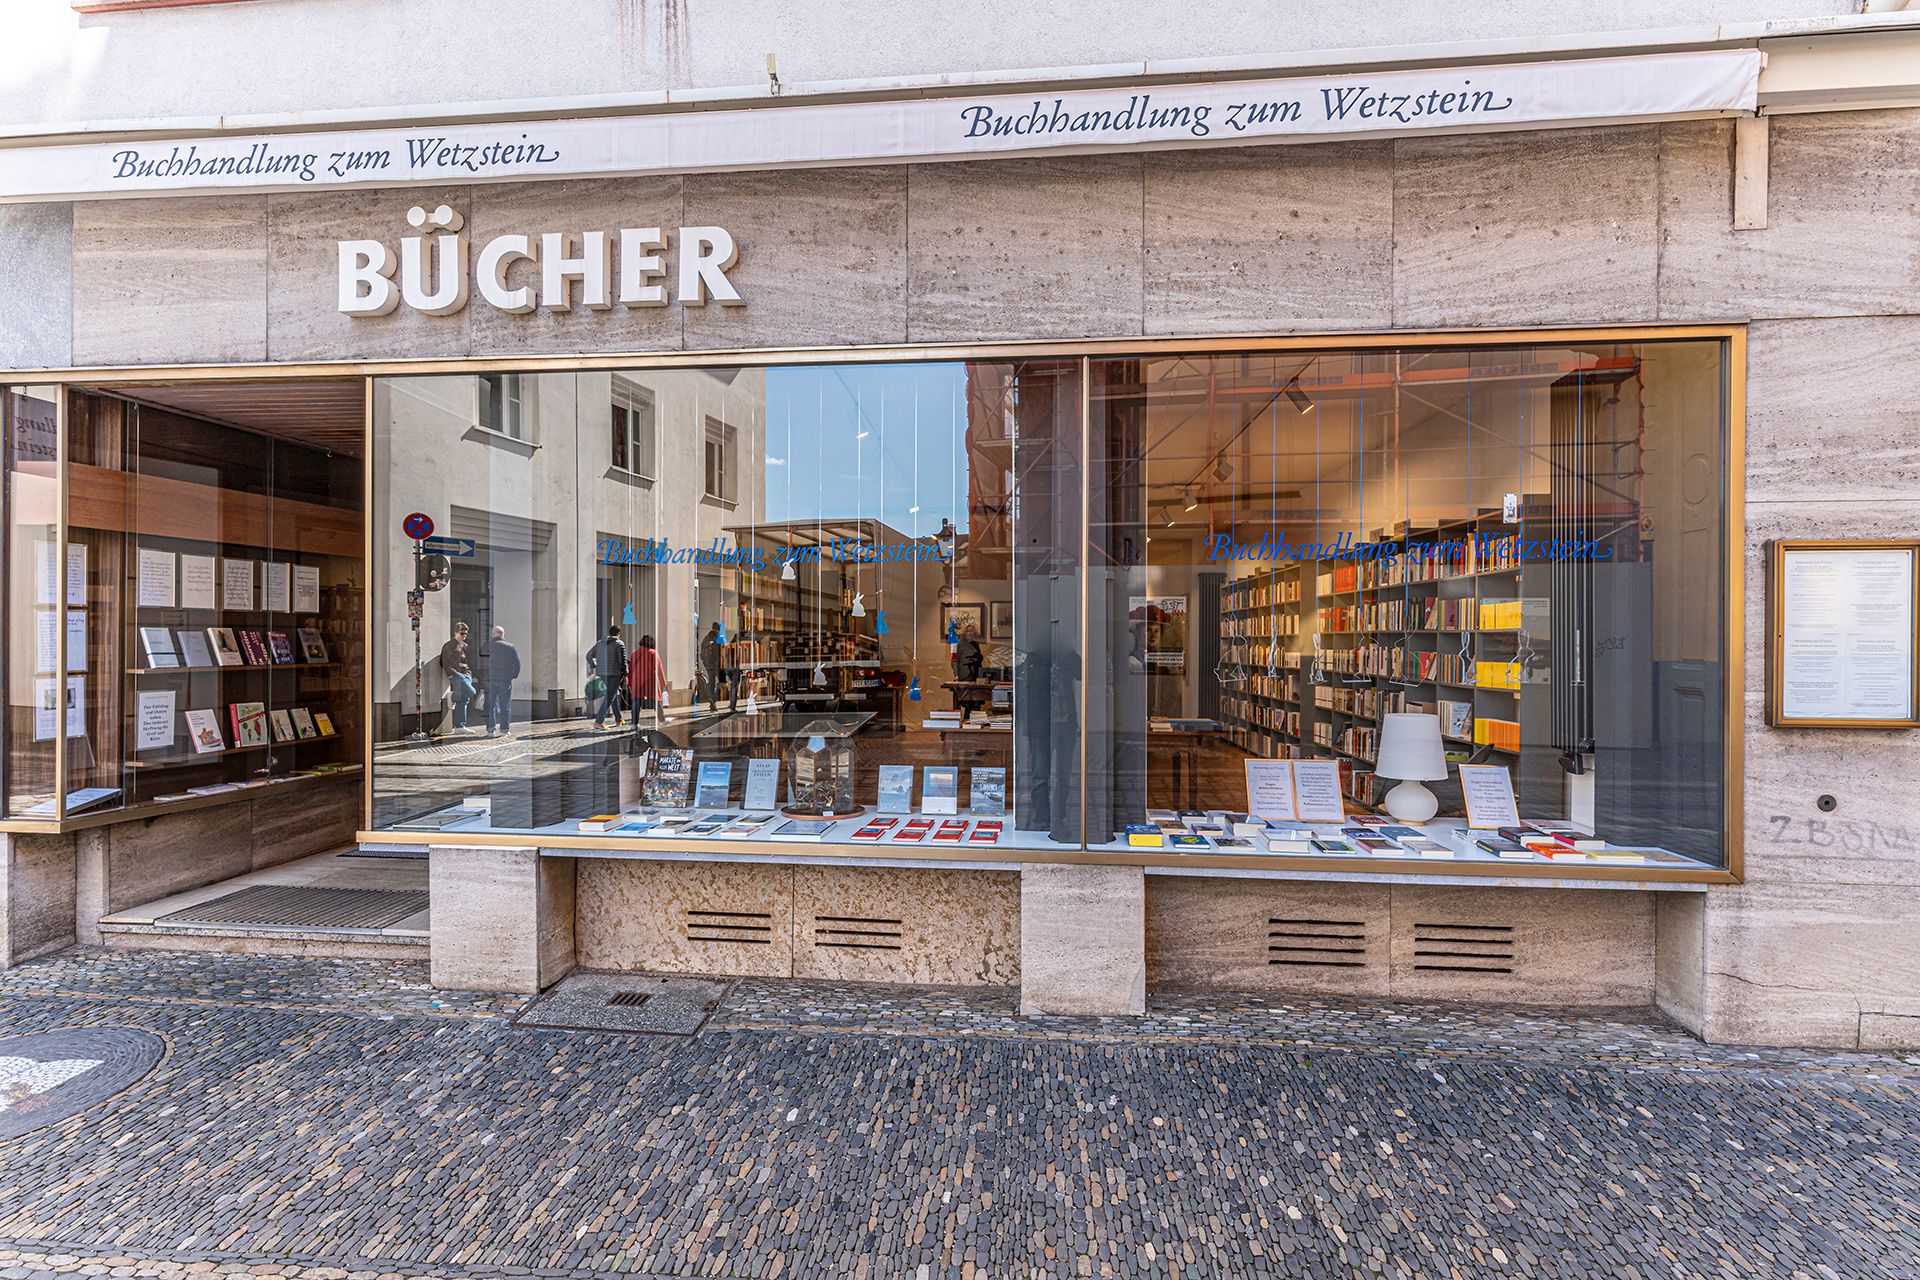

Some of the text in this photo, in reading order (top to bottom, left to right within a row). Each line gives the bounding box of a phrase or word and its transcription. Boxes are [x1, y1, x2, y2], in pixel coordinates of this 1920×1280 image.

[960, 79, 1514, 138] Buchhandlung zum Wetzstein
[112, 133, 560, 182] Buchhandlung zum Wetzstein
[337, 204, 747, 318] BÜCHER
[597, 535, 952, 570] Buchhandlung zum Wetzstein
[1203, 529, 1614, 568] Buchhandlung zum Wetzstein
